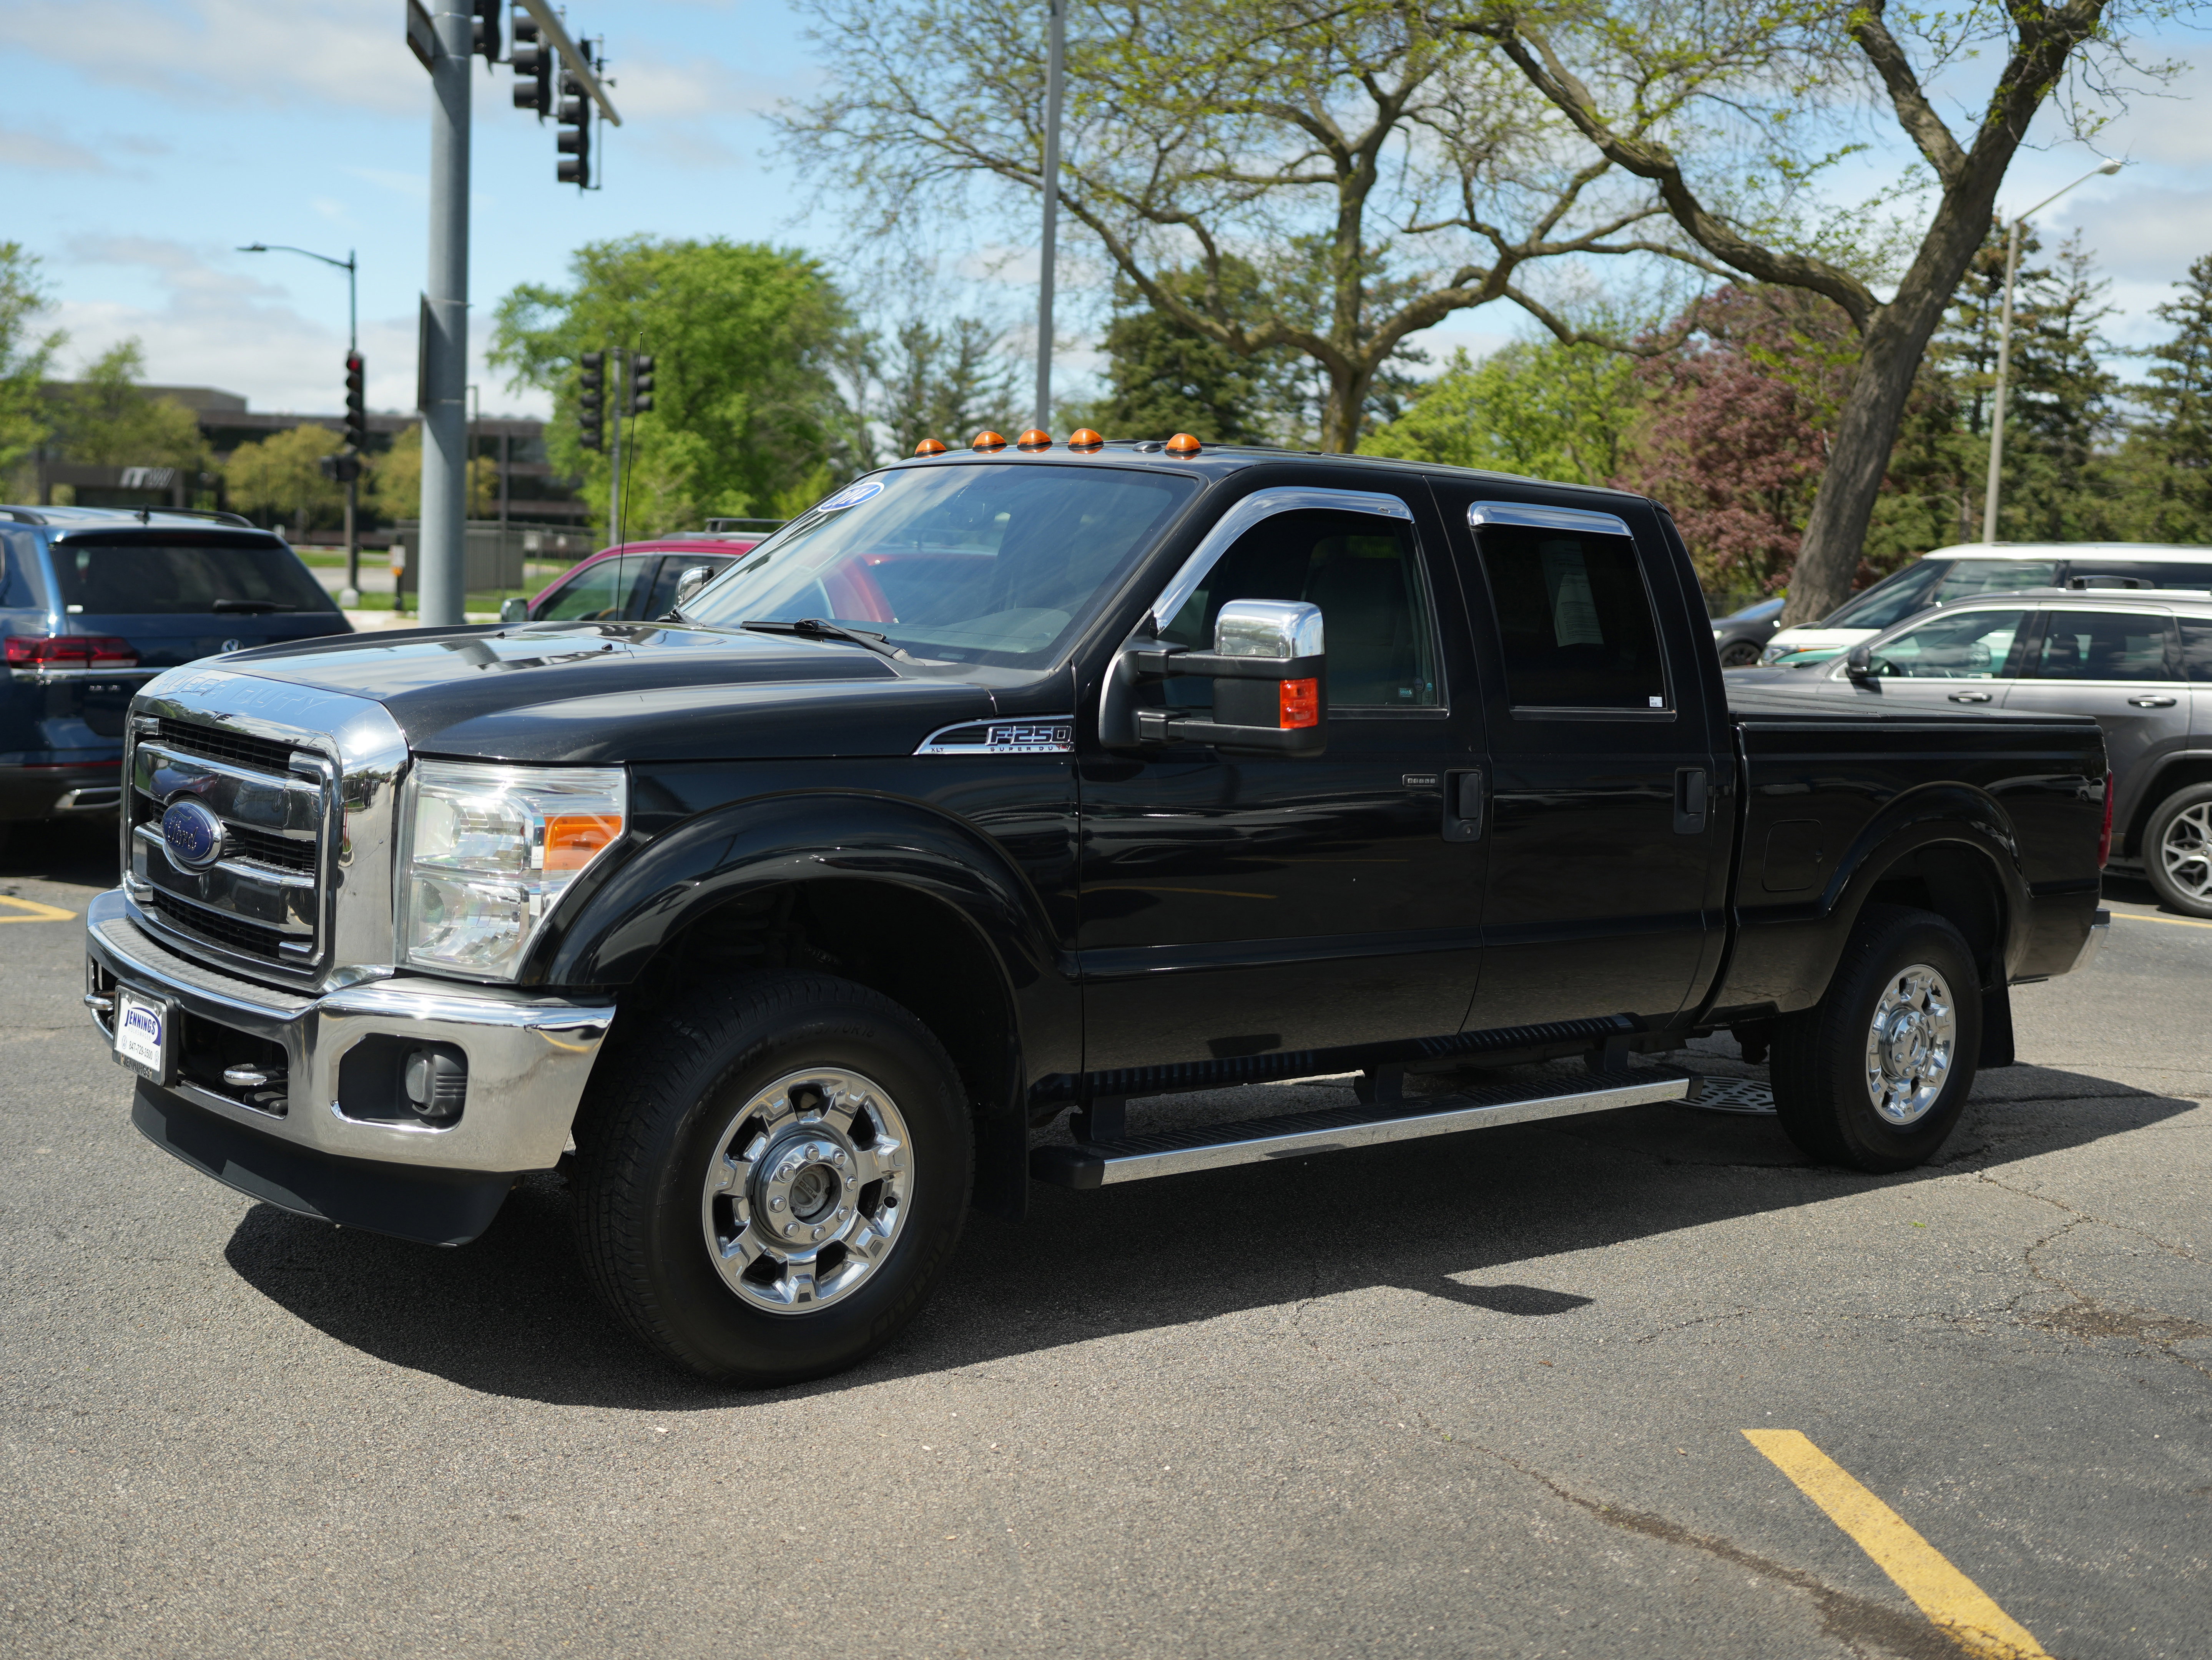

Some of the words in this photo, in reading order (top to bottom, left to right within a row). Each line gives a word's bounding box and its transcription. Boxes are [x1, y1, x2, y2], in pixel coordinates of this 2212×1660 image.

[823, 486, 880, 508] 2014
[157, 673, 234, 699] SUPER
[228, 685, 329, 715] DUTY
[165, 810, 198, 851] Ford
[125, 1009, 155, 1035] JENNINGS
[128, 1026, 151, 1041] VOLKSWAGEN
[129, 1041, 153, 1060] 847-729-3500
[123, 1056, 149, 1077] JENNINGS
[799, 1180, 817, 1199] FORD
